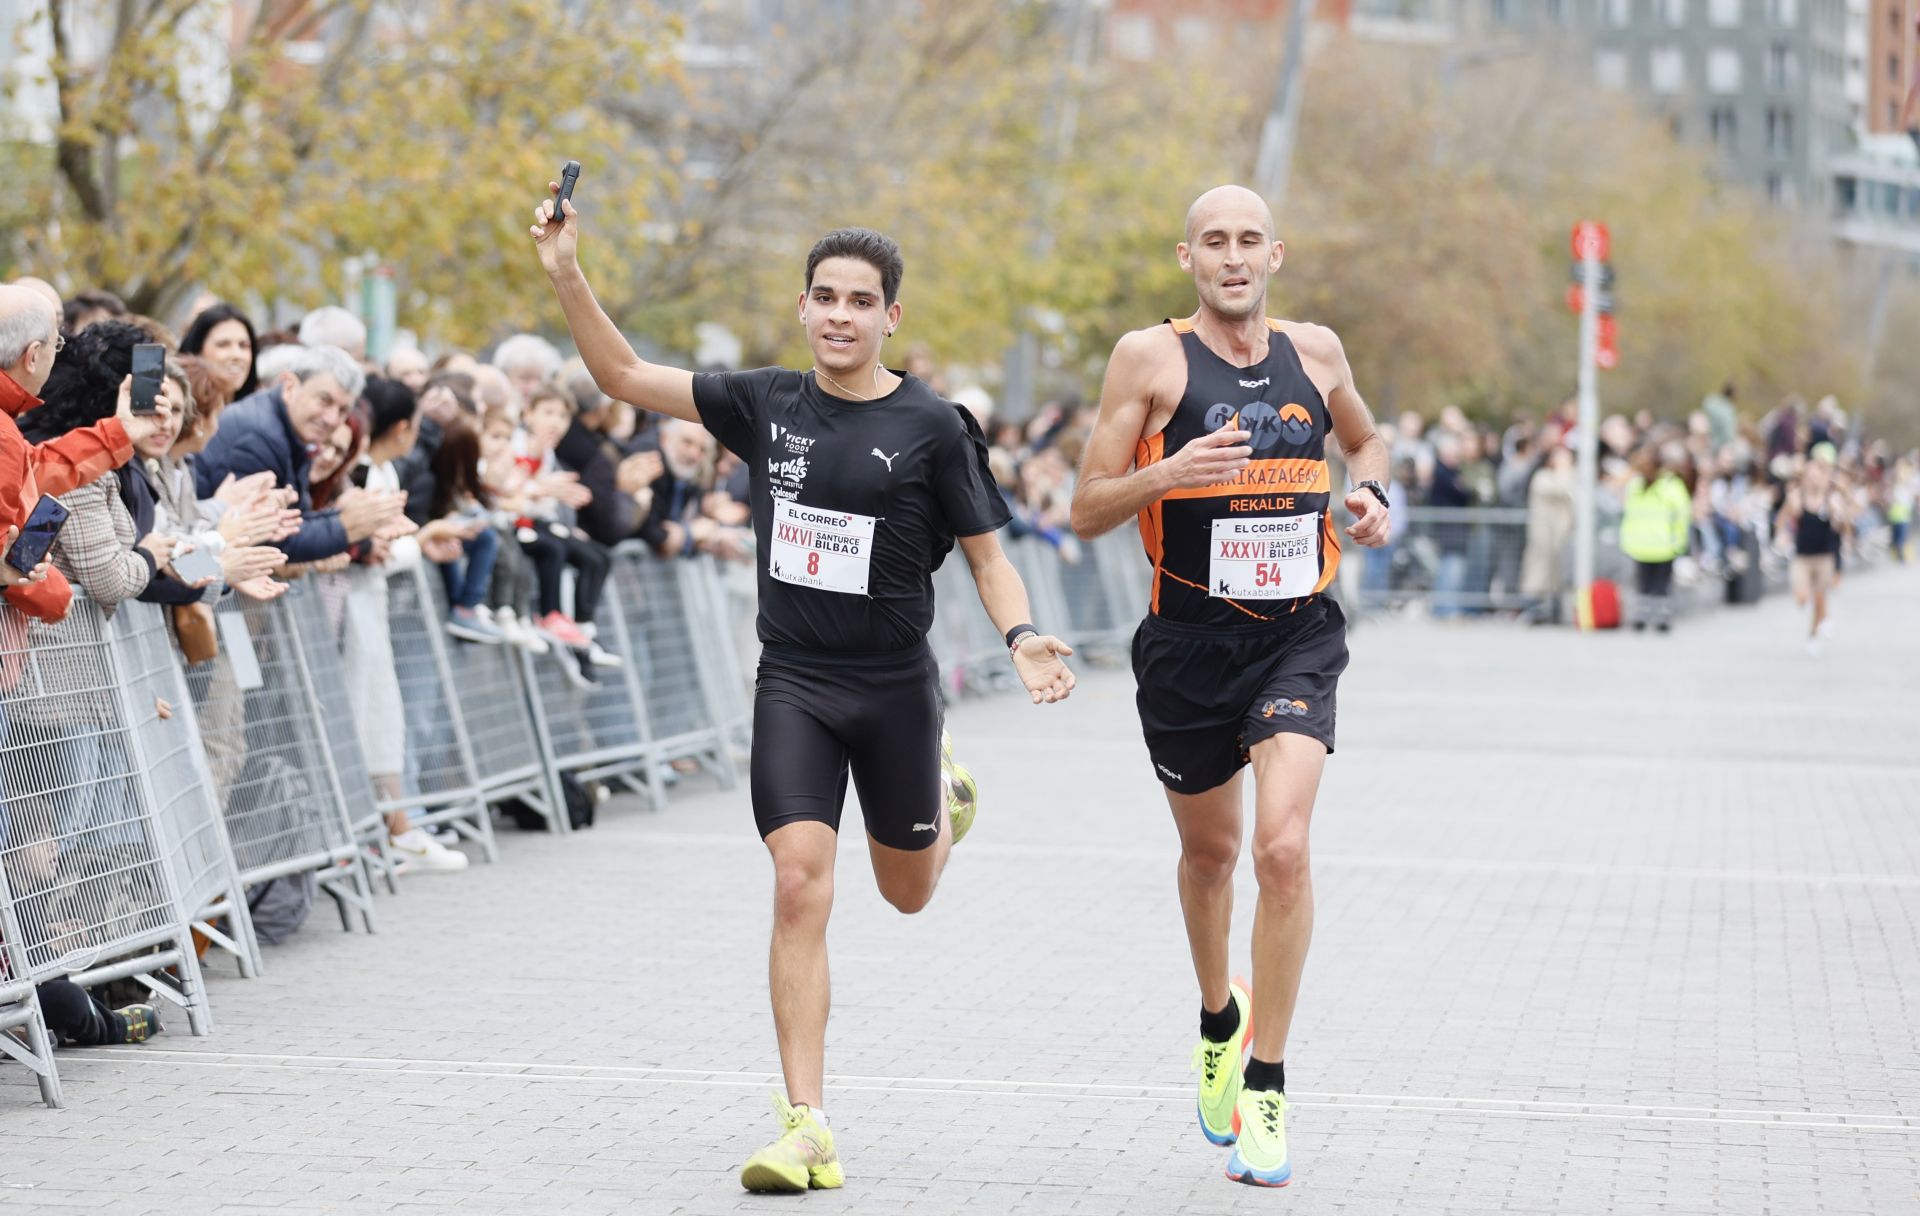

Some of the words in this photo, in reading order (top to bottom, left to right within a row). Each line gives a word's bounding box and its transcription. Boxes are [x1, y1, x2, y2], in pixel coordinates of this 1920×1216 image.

[784, 442, 809, 452] FOODS
[786, 433, 816, 447] VICKY
[768, 457, 780, 474] be
[780, 457, 808, 479] plus
[1230, 497, 1295, 512] REKALDE
[788, 508, 800, 519] EL
[801, 512, 848, 528] CORREO
[777, 522, 813, 547] XXXVI
[1234, 524, 1249, 533] EL
[1251, 522, 1299, 533] CORREO
[816, 532, 860, 546] SANTURCE
[1270, 537, 1309, 549] SANTURCE
[815, 540, 859, 555] BILBAO
[1220, 541, 1265, 559] XXXVI
[1269, 546, 1308, 558] BILBAO
[807, 551, 820, 576] 8
[781, 571, 823, 586] kutxabank
[1255, 562, 1282, 587] 54
[1231, 587, 1281, 597] kutxabank
